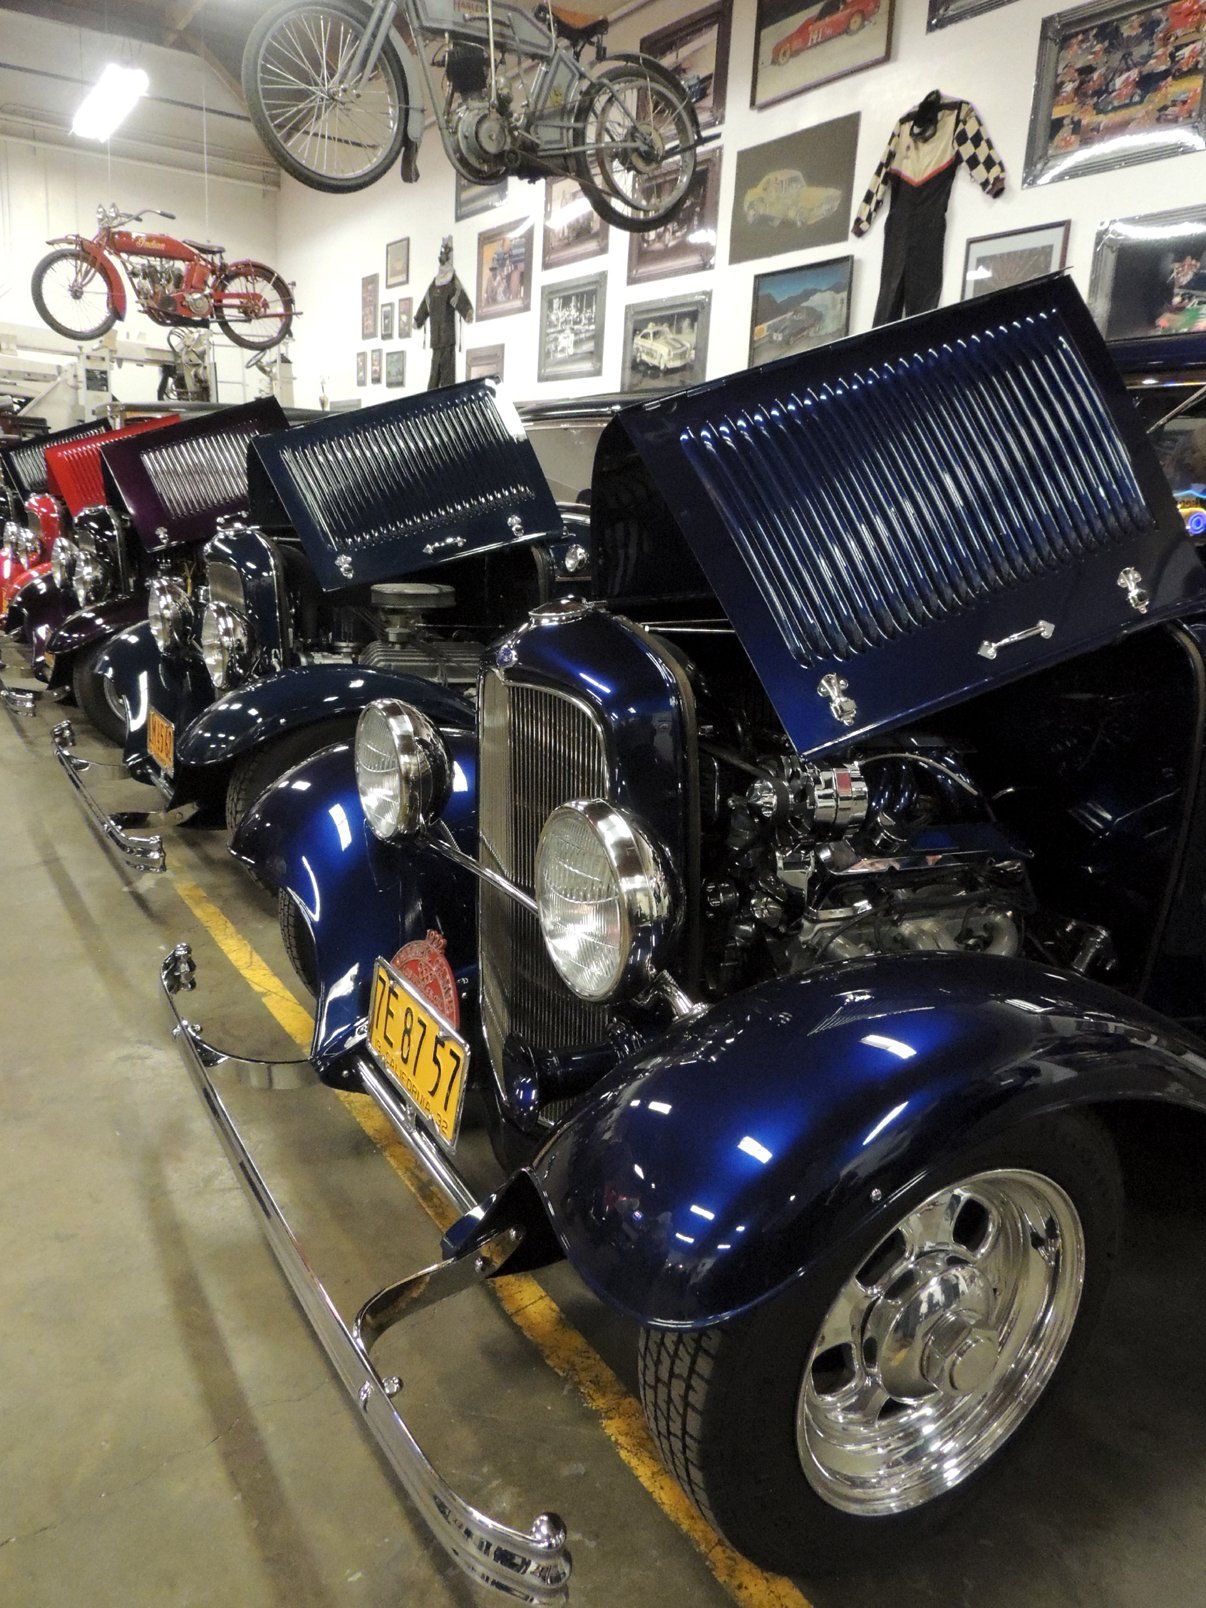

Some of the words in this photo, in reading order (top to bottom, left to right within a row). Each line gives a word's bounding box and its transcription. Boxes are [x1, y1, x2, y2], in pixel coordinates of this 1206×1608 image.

[374, 974, 398, 1047] 7E
[401, 1006, 427, 1077] 87
[428, 1034, 461, 1112] 57
[435, 1112, 448, 1135] 32
